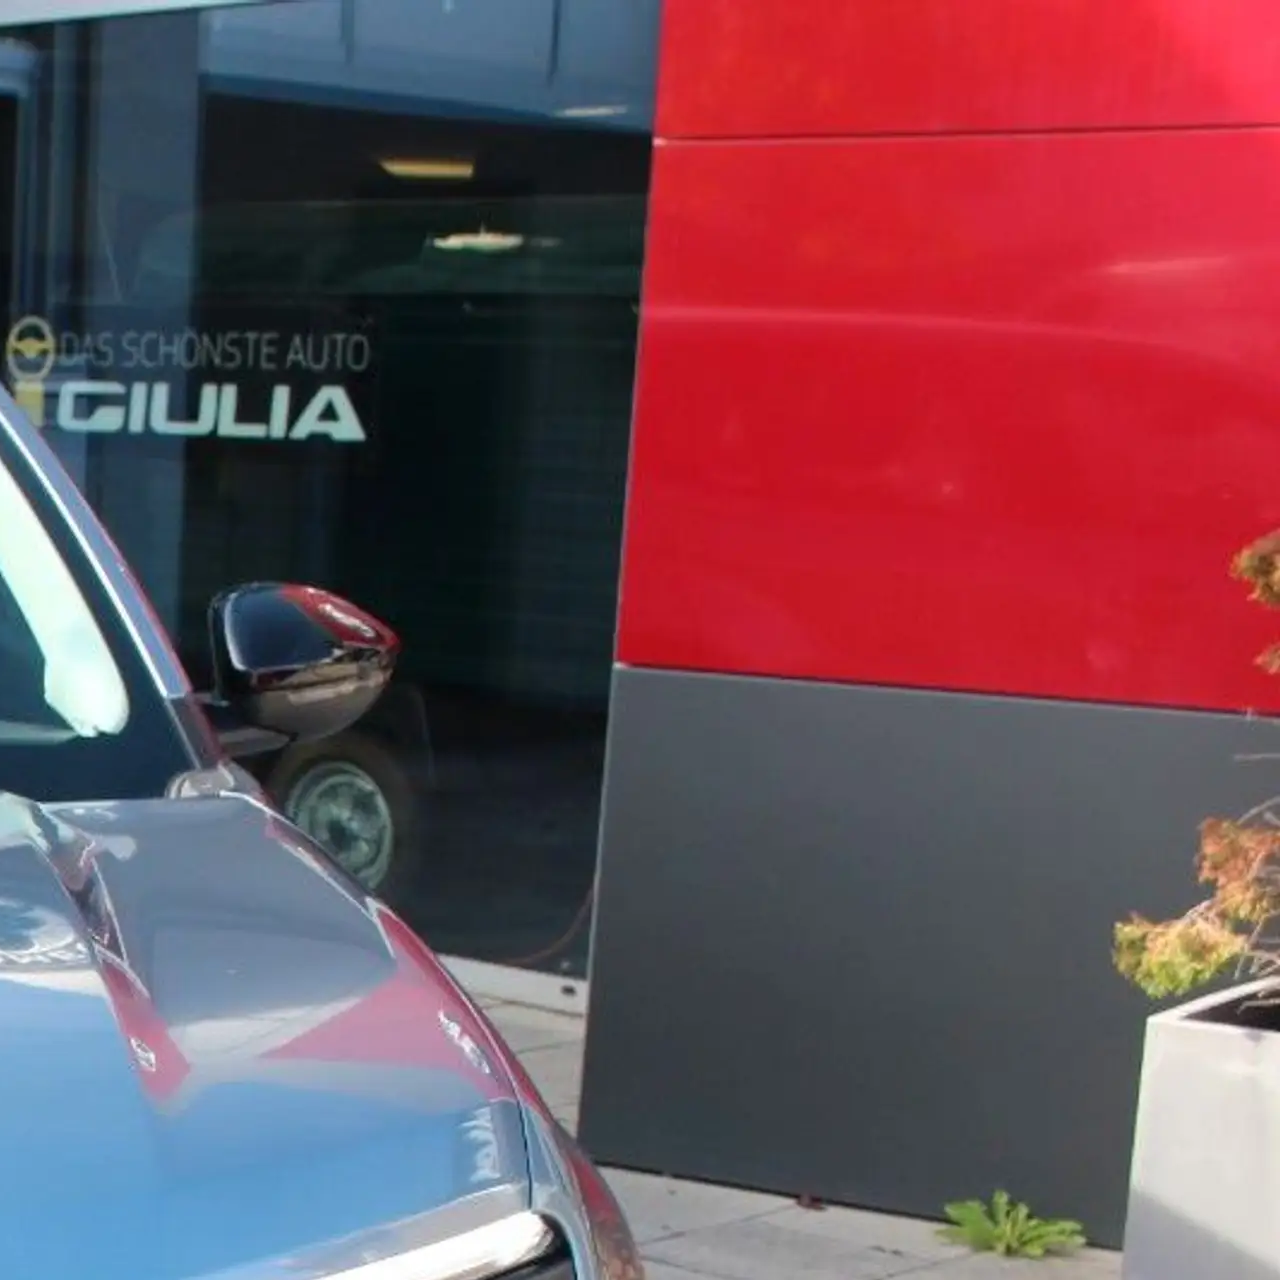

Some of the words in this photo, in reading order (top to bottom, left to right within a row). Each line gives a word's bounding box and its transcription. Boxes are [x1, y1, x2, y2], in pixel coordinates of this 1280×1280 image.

[59, 331, 115, 367] DAS
[286, 333, 370, 371] AUTO
[57, 381, 366, 442] GIULIA
